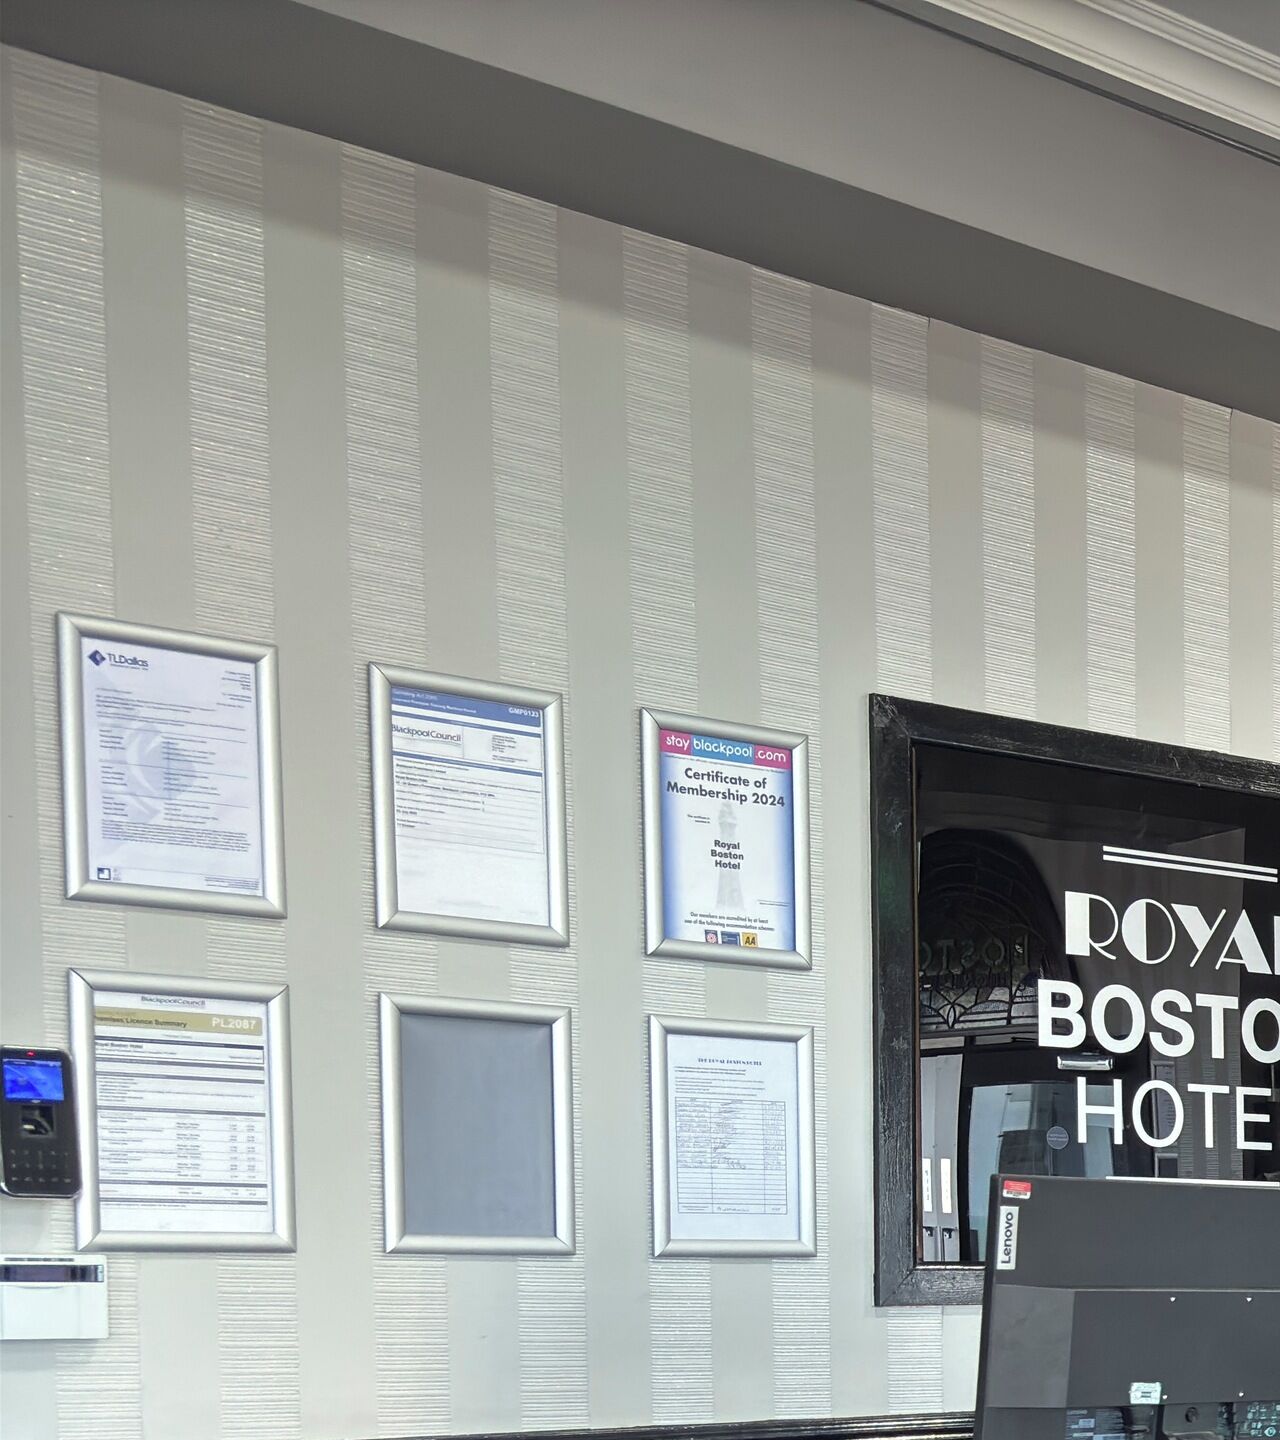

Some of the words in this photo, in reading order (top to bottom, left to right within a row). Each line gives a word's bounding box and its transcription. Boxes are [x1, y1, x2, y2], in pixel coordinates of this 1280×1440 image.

[665, 736, 690, 750] stay
[693, 739, 753, 757] blackpool
[684, 767, 750, 787] Certificate
[753, 777, 768, 789] of
[666, 781, 748, 805] Membership
[752, 792, 785, 807] 2024
[714, 839, 740, 851] Royal
[710, 849, 744, 861] Boston
[714, 859, 741, 870] Hotel
[211, 1016, 256, 1030] PL2087
[1001, 1211, 1014, 1264] Lenovo
